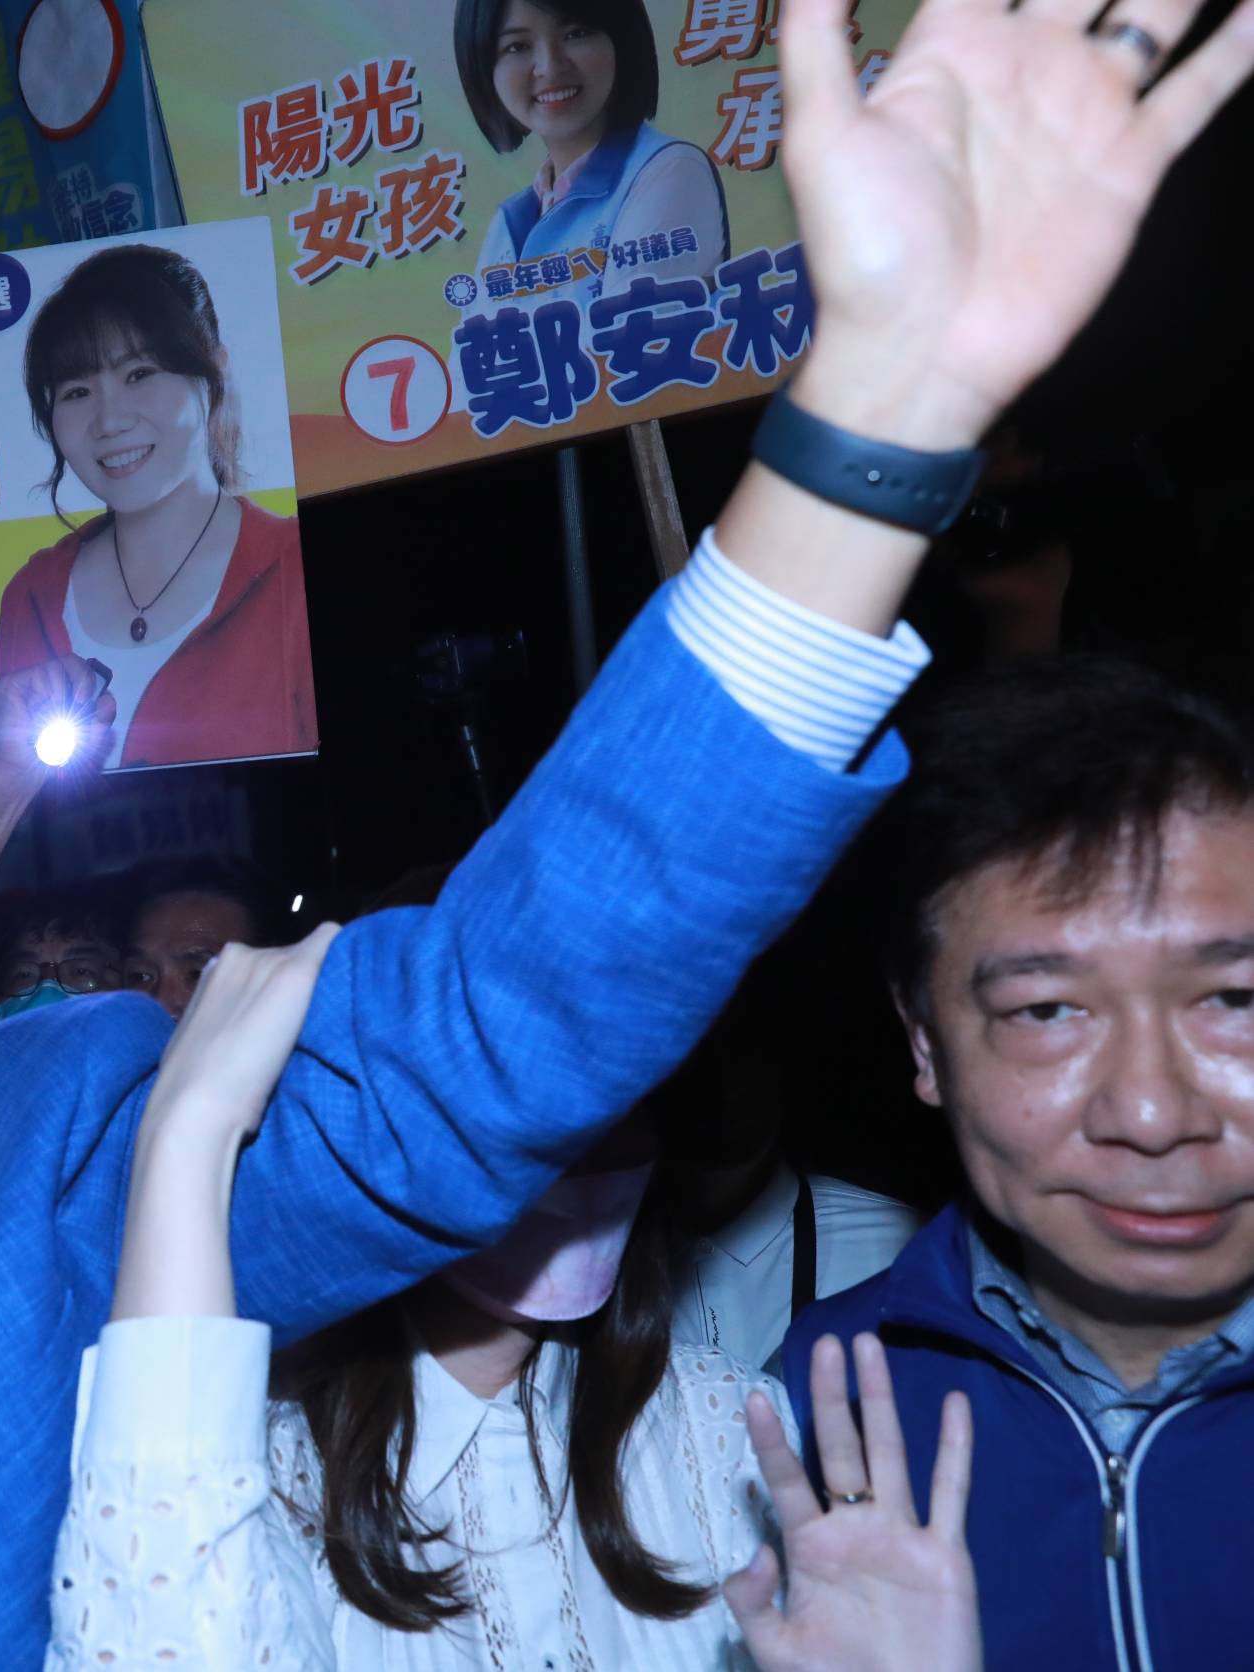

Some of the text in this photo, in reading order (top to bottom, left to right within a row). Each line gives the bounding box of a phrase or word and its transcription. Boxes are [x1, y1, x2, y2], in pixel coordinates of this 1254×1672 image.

[242, 58, 418, 192] 陽光
[294, 152, 464, 280] 女孩
[366, 356, 418, 432] 7
